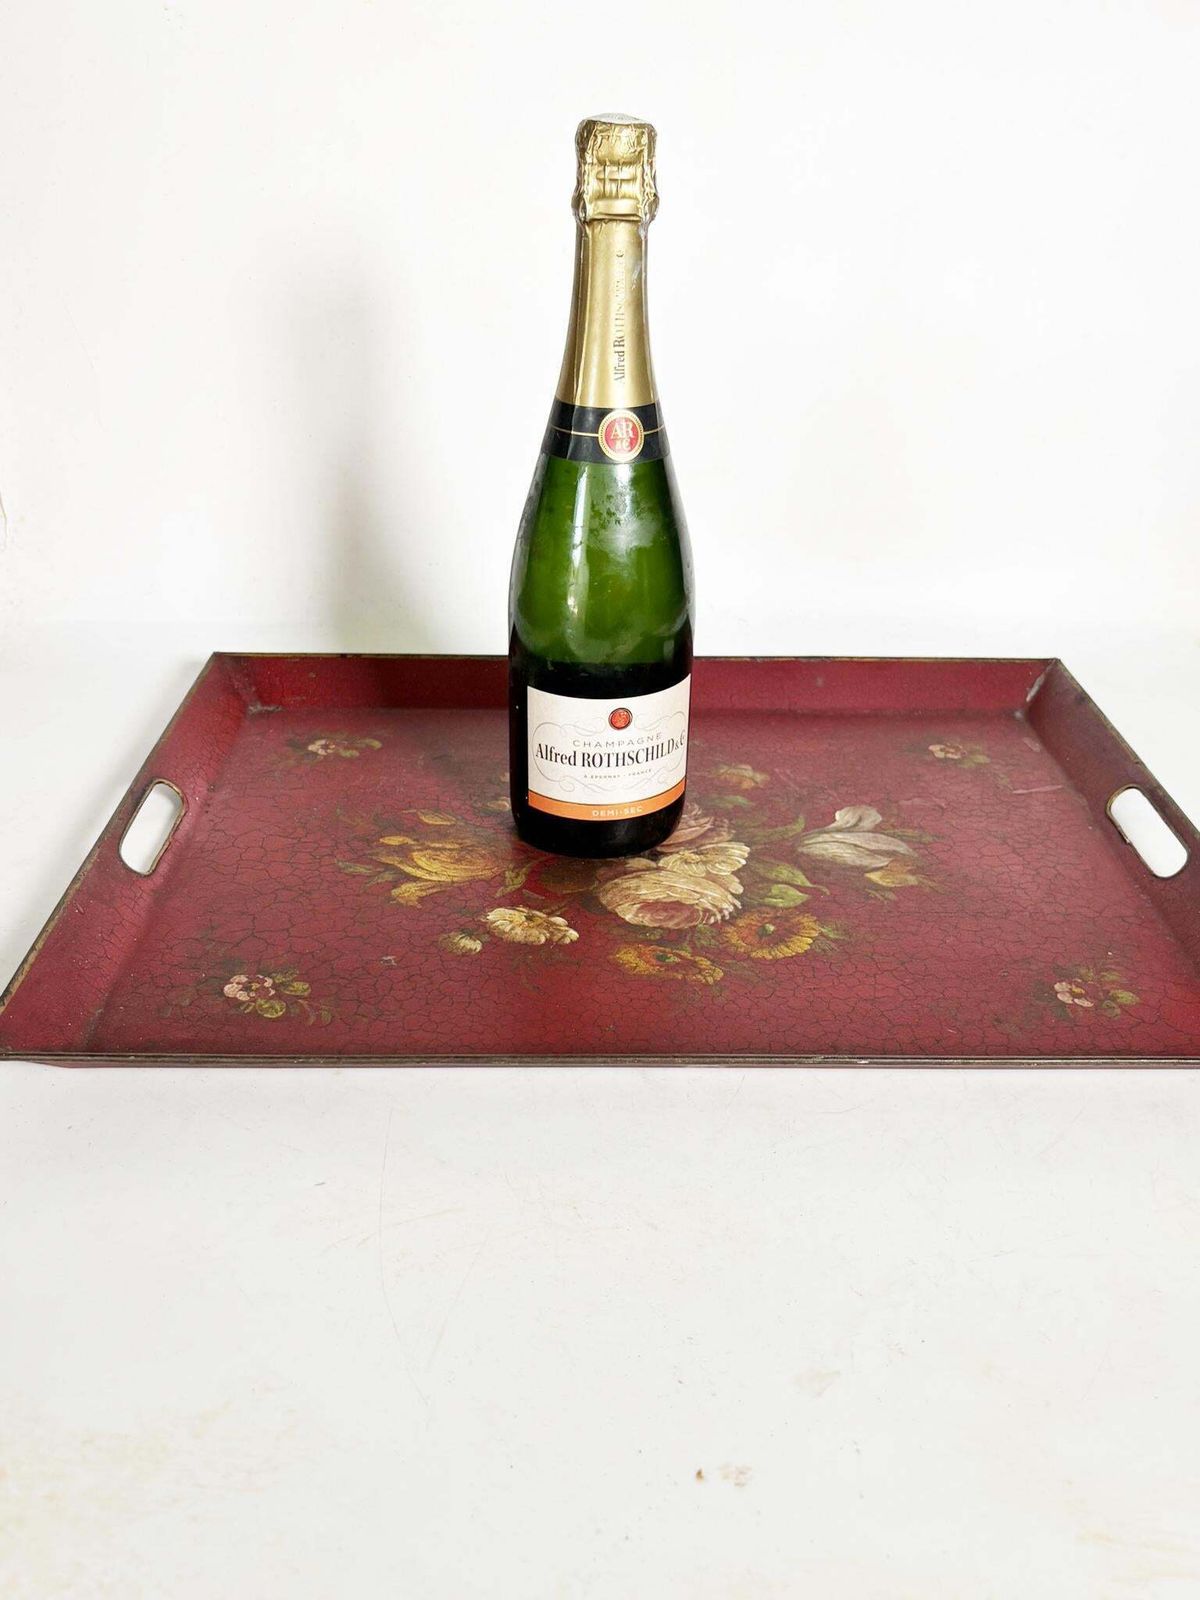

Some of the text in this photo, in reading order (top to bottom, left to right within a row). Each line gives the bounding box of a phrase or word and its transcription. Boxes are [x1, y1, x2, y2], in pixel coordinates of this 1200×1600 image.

[613, 350, 626, 384] Alfred
[572, 732, 662, 748] CHAMPAGNE
[536, 743, 577, 767] Alfred
